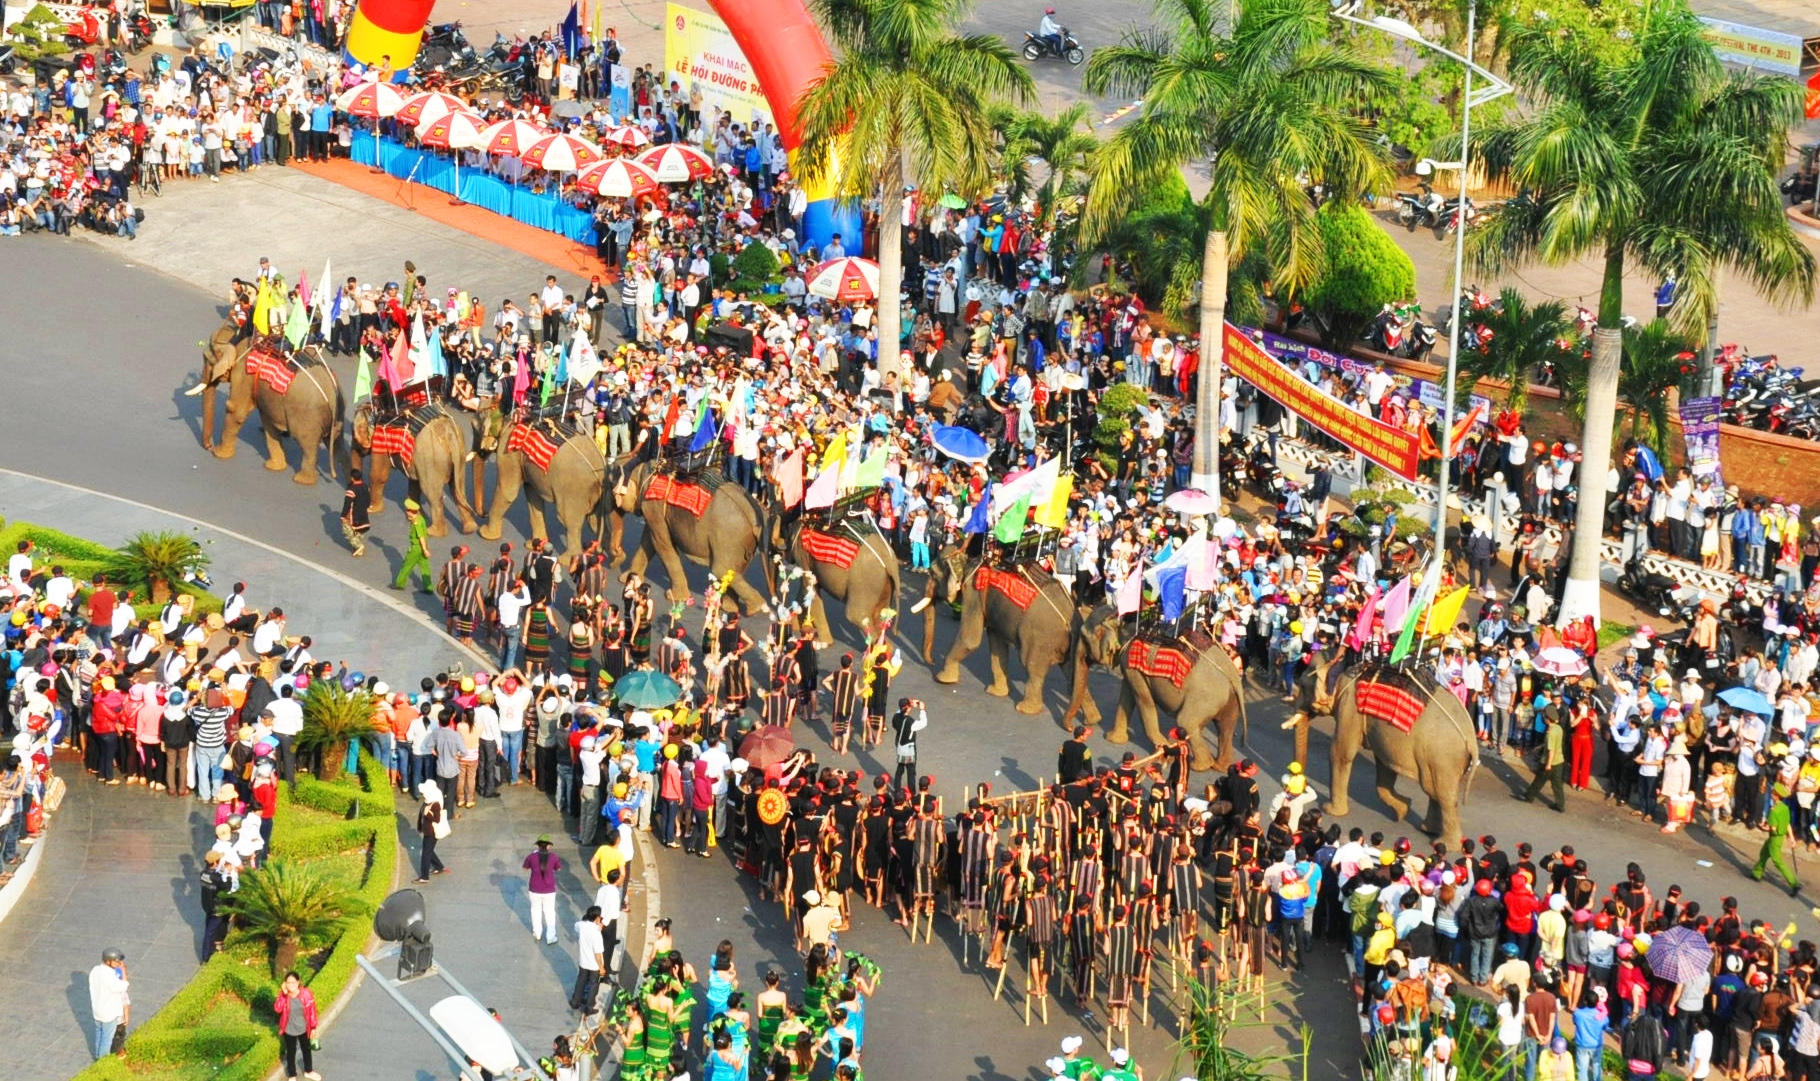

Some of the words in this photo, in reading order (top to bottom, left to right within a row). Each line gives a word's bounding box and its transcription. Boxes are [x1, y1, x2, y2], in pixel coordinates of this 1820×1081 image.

[703, 52, 724, 66] KHAI
[1747, 42, 1758, 53] THE
[1760, 45, 1771, 56] 4TH
[1776, 48, 1791, 60] 2013
[675, 57, 689, 74] LỄ
[691, 65, 708, 81] HỘI
[711, 71, 747, 92] ĐƯỜNG
